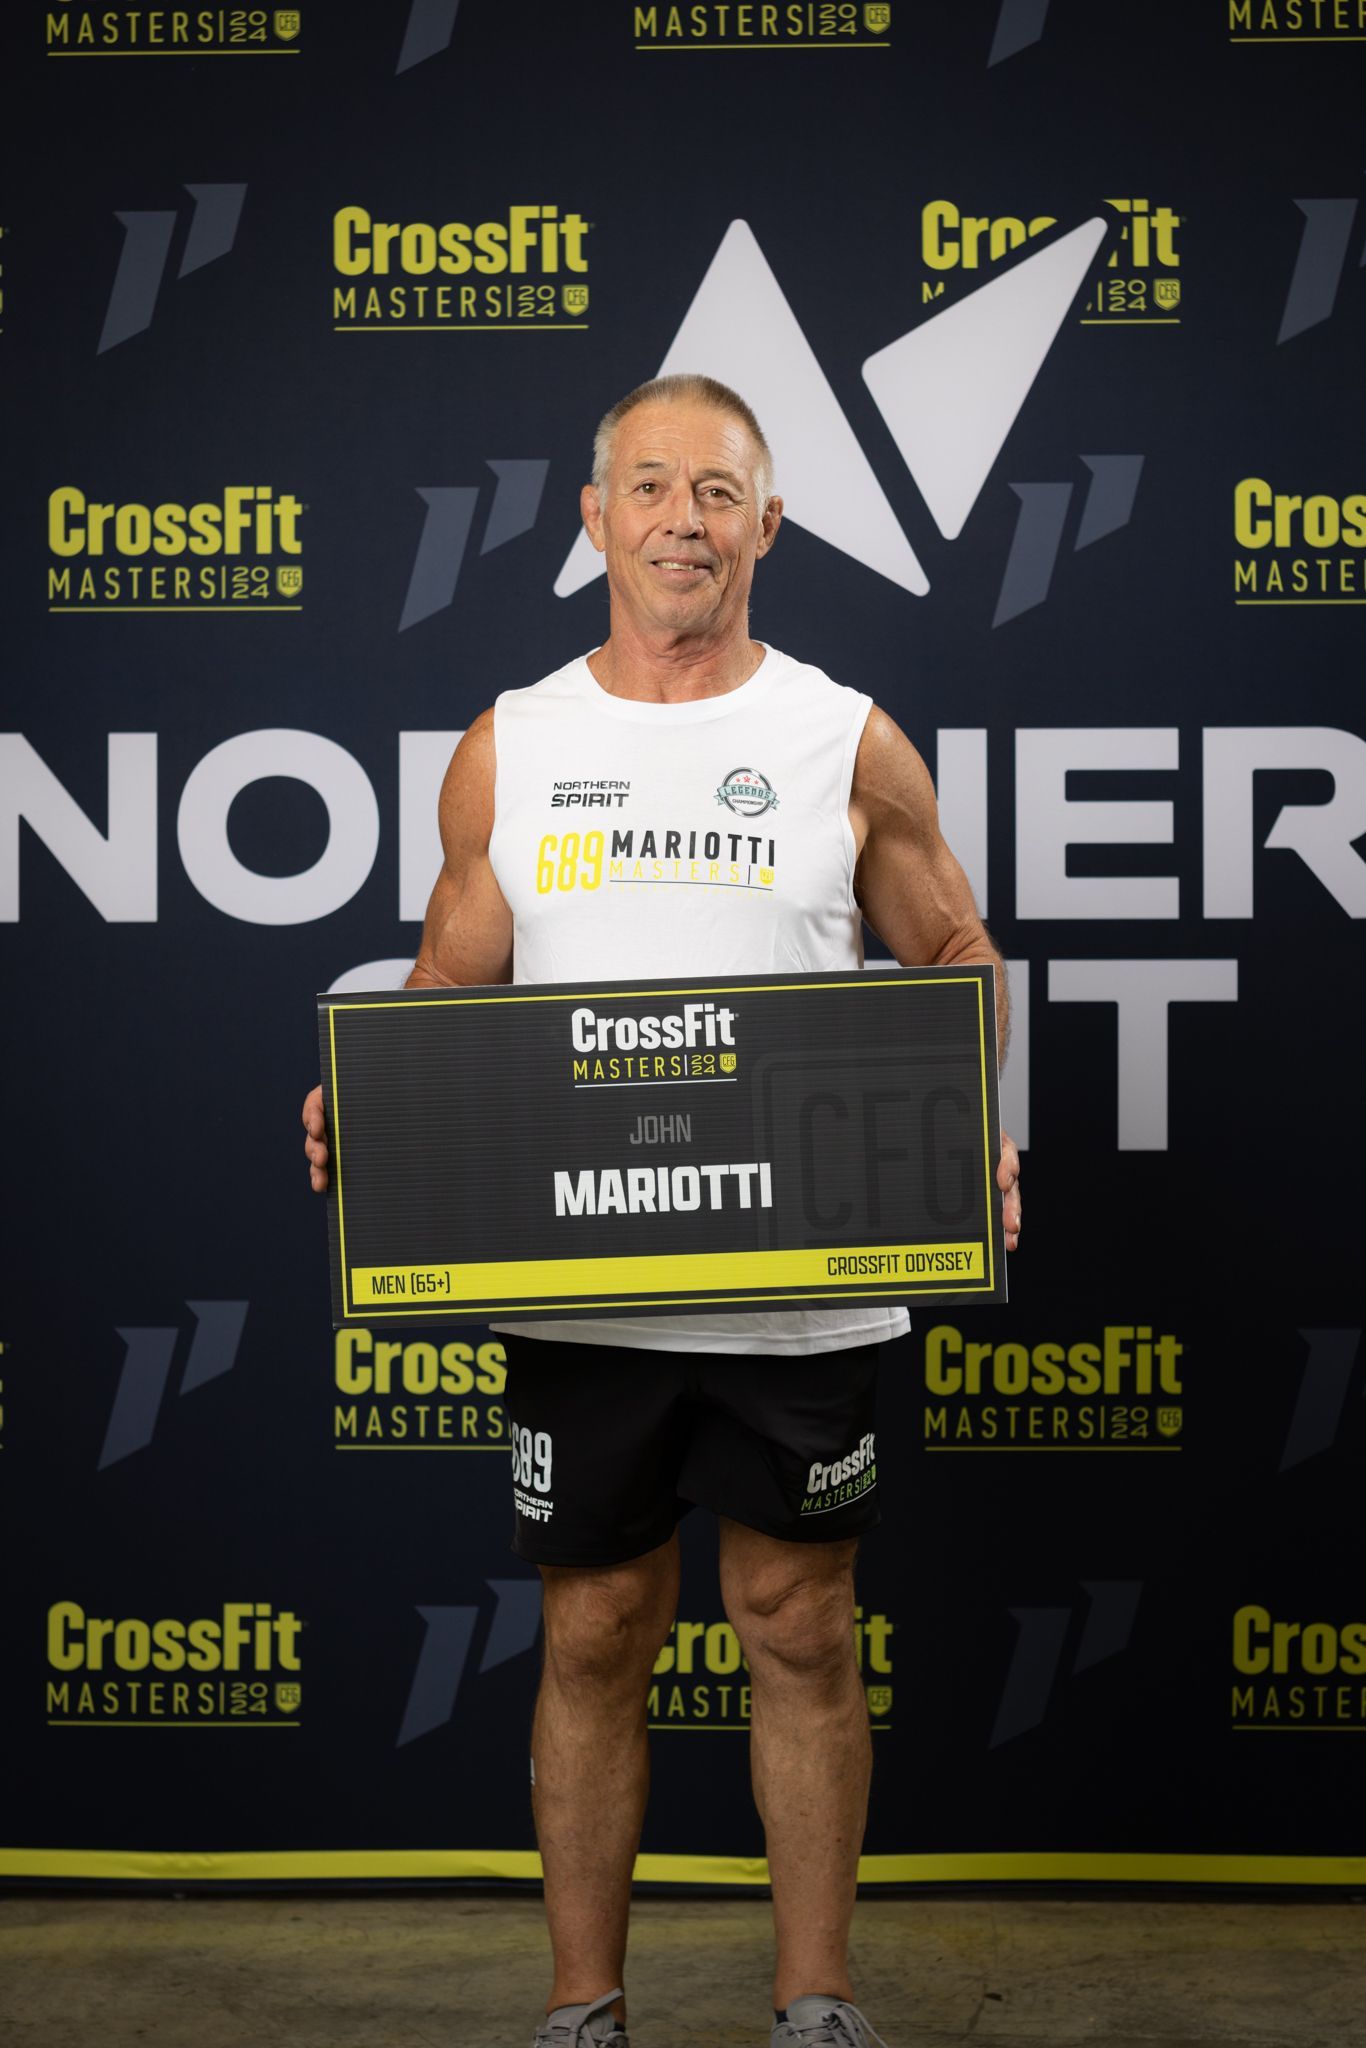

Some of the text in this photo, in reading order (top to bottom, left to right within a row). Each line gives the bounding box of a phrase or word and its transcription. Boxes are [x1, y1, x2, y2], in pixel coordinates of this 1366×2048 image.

[47, 11, 213, 44] MASTERS
[634, 5, 803, 38] MASTERS
[334, 206, 588, 275] CrossFit
[922, 199, 1180, 271] Croit
[334, 287, 501, 318] MASTERS
[49, 487, 302, 556] CrossFit
[1235, 478, 1366, 549] Cros
[49, 567, 215, 600] MASTERS
[1235, 559, 1366, 592] MASTE
[551, 793, 629, 808] SPIRIT
[553, 780, 631, 791] NORTHERN
[723, 785, 771, 799] LEGENDS
[536, 829, 775, 895] 689 MARIOTTI
[609, 860, 740, 883] MASTERS
[572, 1003, 736, 1053] CrossFit
[573, 1055, 682, 1081] MASTERS
[629, 1113, 693, 1146] JOHN
[554, 1162, 773, 1217] MARIOTTI
[828, 1251, 972, 1276] CROSSFIT ODYSSEY
[372, 1275, 406, 1295] MEN
[335, 1328, 507, 1395] Cross
[925, 1326, 1182, 1395] CrossFit
[335, 1405, 503, 1439] MASTERS
[925, 1407, 1094, 1439] MASTERS
[807, 1432, 876, 1494] CrossFit
[514, 1488, 554, 1510] ORTHERN
[515, 1497, 553, 1523] PIRIT
[801, 1482, 860, 1512] MASTERS
[48, 1602, 301, 1672] CrossFit
[1233, 1605, 1366, 1675] Cros
[48, 1681, 214, 1715] MASTERS
[647, 1685, 751, 1718] ASTE
